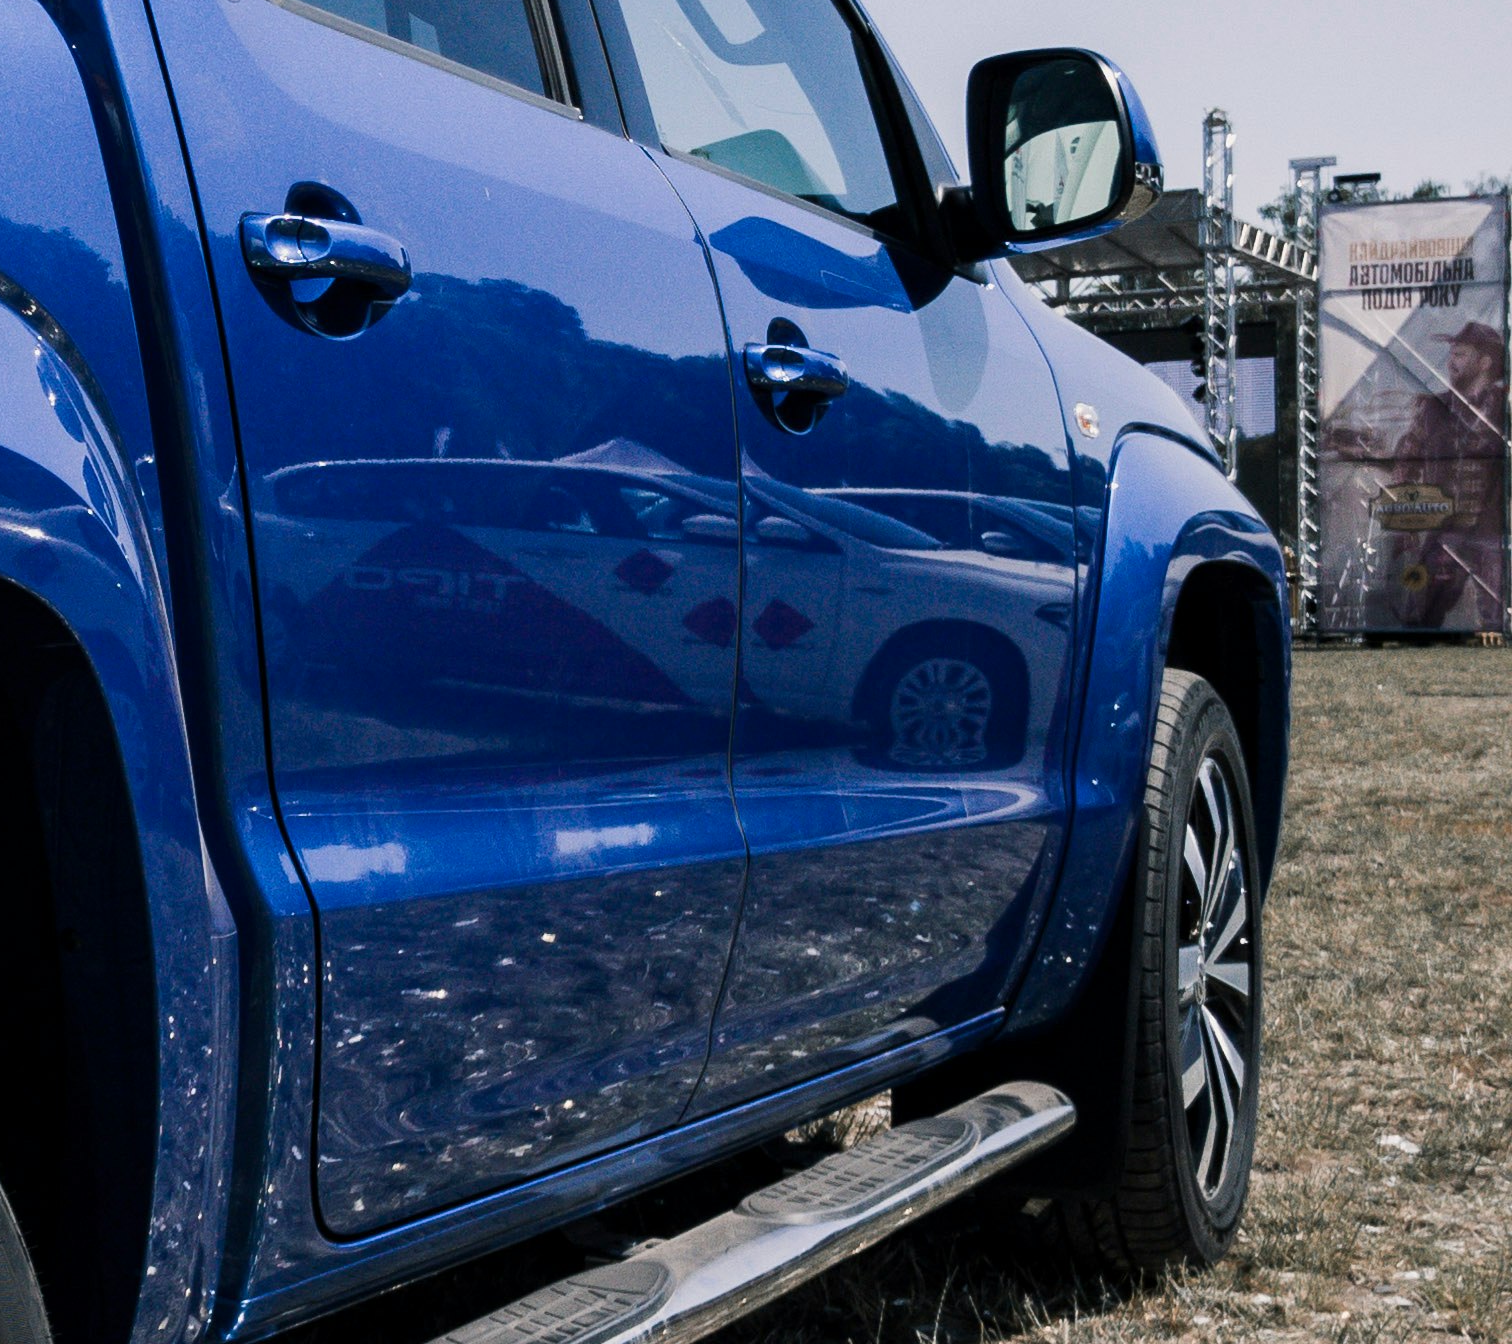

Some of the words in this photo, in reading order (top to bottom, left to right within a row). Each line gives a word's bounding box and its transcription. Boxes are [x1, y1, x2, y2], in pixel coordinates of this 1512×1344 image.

[1349, 257, 1475, 286] АВТОМОБІЛЬНА
[1361, 288, 1412, 311] ПОДІЯ
[1420, 284, 1462, 308] РОКУ
